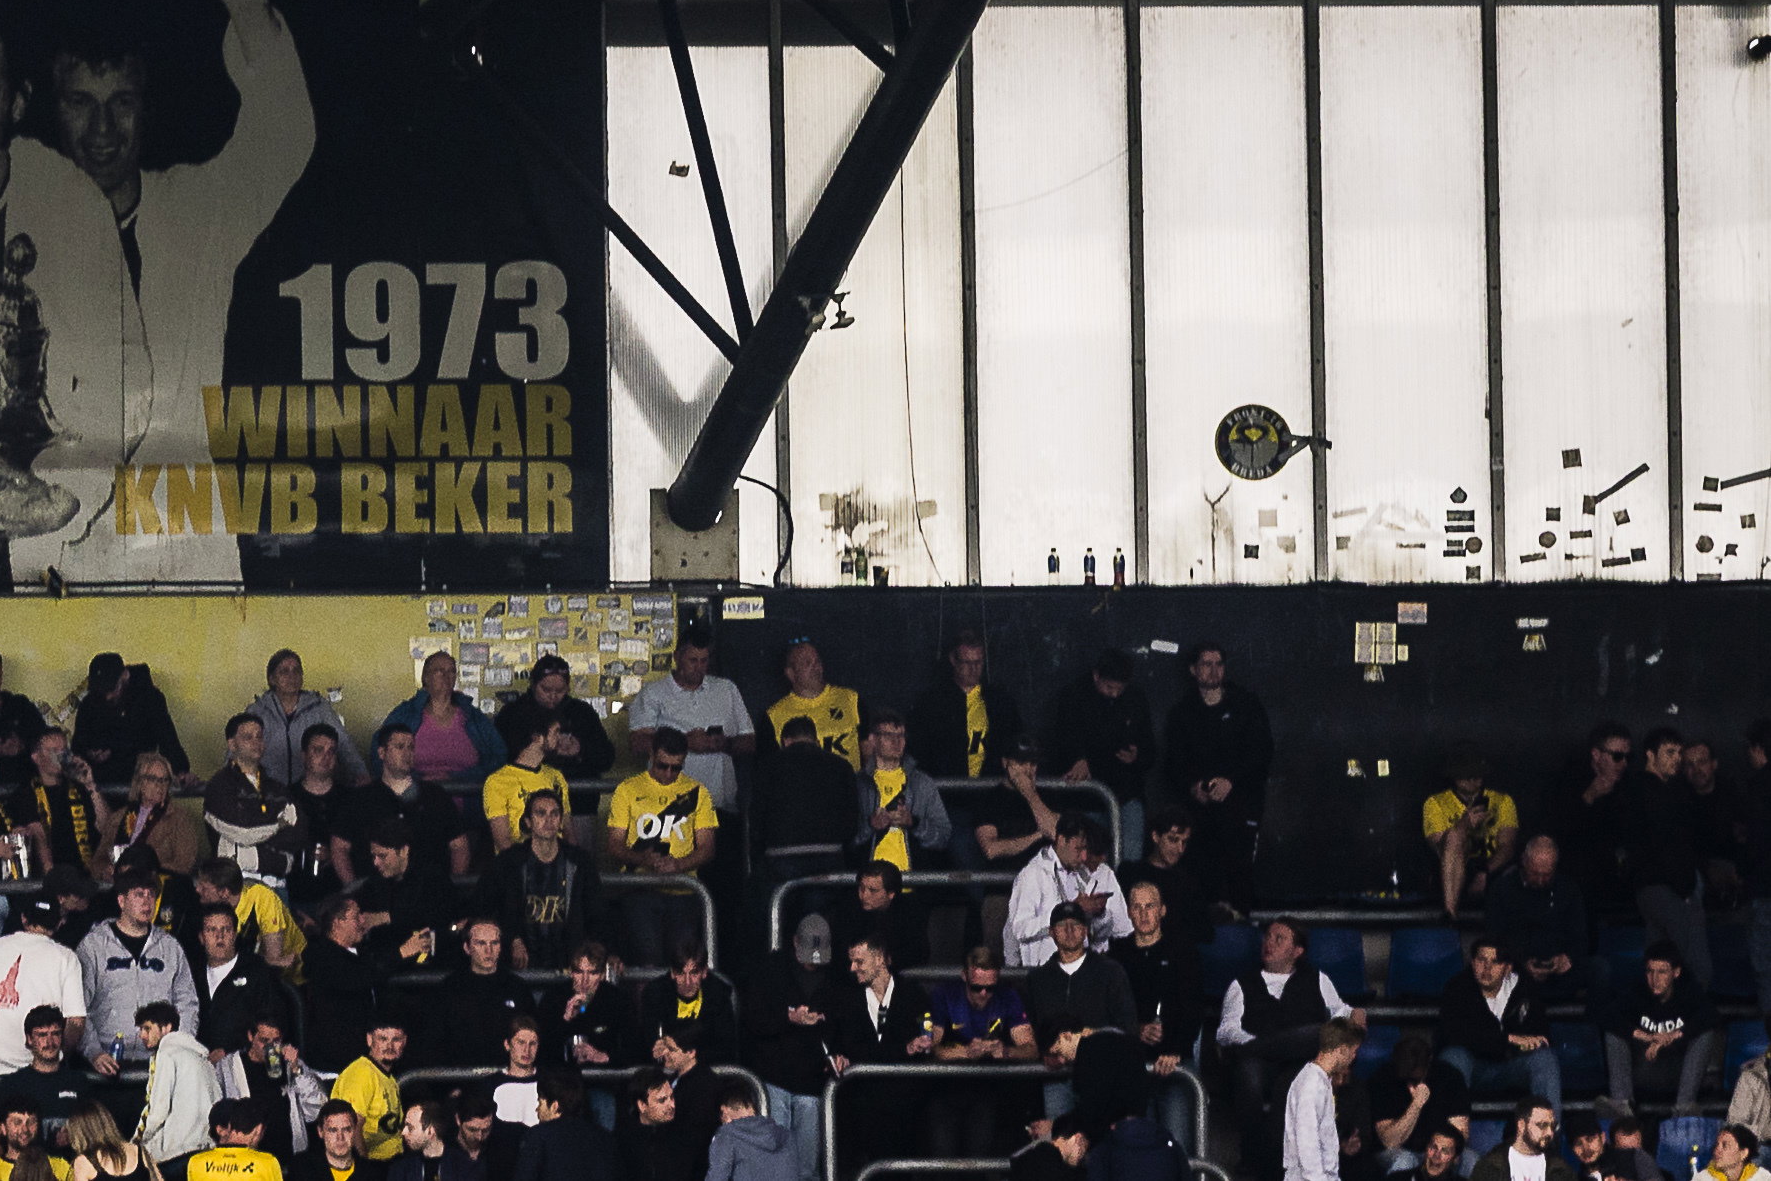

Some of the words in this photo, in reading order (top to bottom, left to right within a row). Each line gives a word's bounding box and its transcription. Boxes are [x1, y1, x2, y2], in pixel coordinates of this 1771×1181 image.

[278, 260, 570, 382] 1973
[201, 384, 573, 458] WINNAAR
[114, 463, 318, 535] KNVB
[340, 461, 573, 534] BEKER
[636, 812, 688, 842] OK
